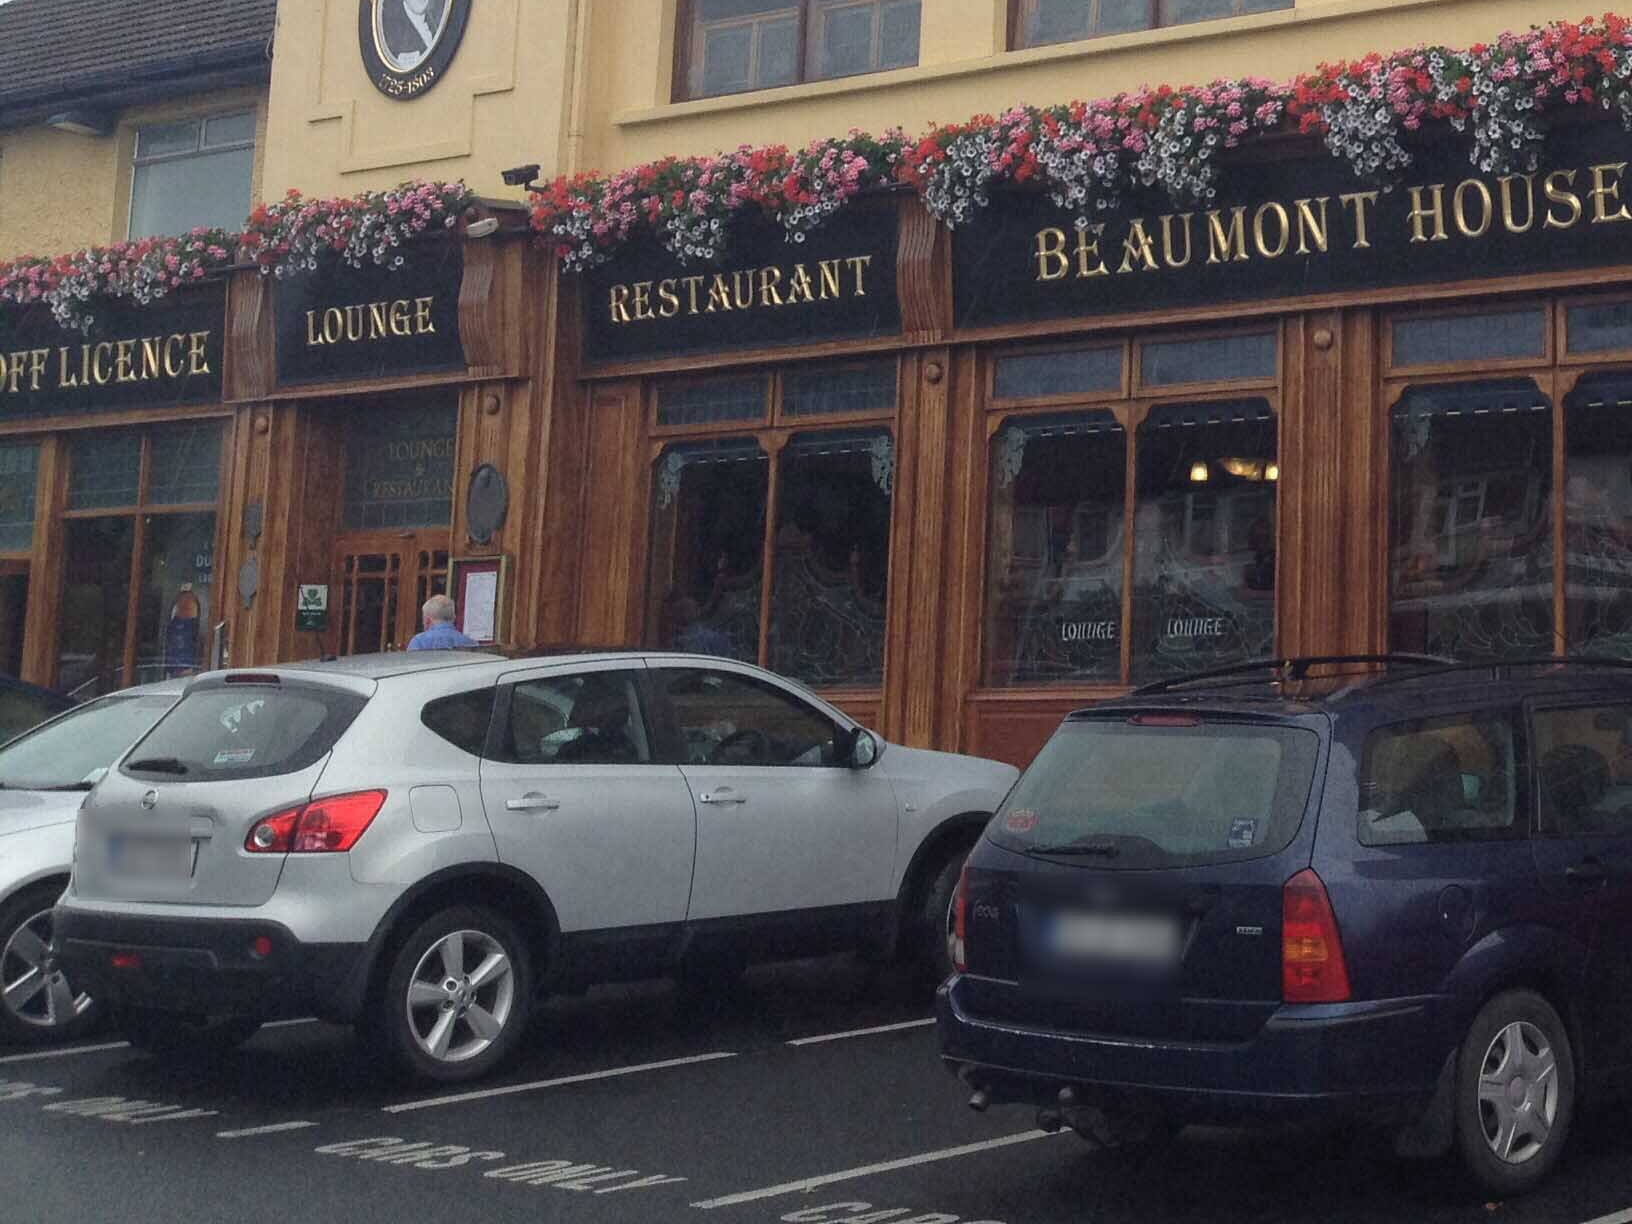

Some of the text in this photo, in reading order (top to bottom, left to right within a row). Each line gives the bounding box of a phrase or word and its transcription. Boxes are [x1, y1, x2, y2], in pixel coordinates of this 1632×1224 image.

[1034, 162, 1632, 281] BEAUMONT HOUSE
[609, 255, 873, 323] RESTAURANT
[306, 296, 436, 345] LOUNGE
[58, 330, 211, 388] LICENCE
[1061, 621, 1116, 642] LOUNGE
[1167, 617, 1223, 638] LOUNGE
[315, 1137, 688, 1194] CARS ONLY
